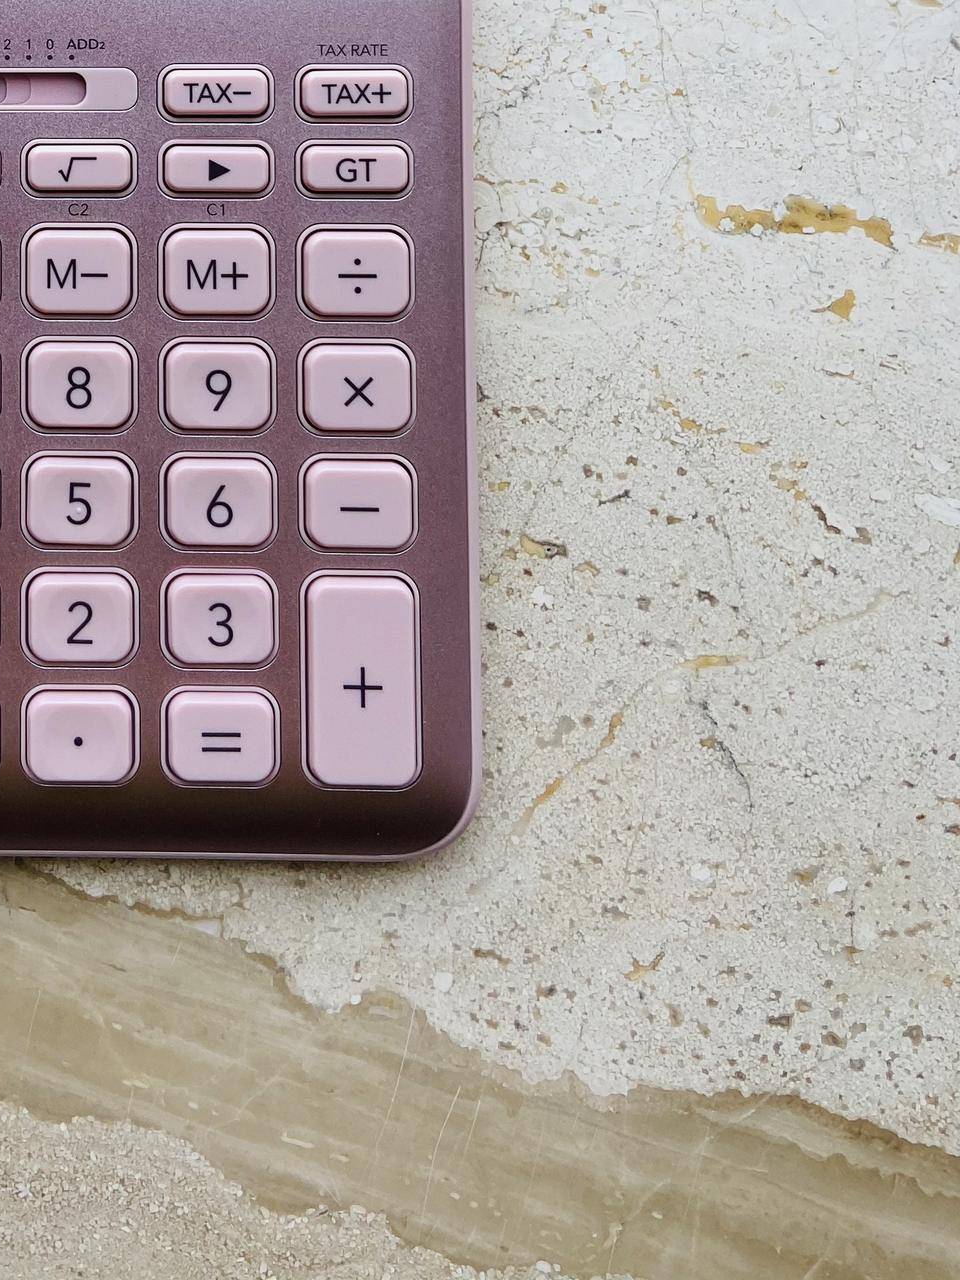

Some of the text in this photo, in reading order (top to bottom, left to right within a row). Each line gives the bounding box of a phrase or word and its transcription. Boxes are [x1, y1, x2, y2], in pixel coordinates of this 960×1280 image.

[3, 39, 12, 50] 2
[25, 39, 32, 50] 1
[46, 39, 55, 50] 0
[317, 44, 389, 57] TAX RATE
[321, 83, 392, 105] TAX+
[335, 158, 377, 183] GT
[68, 204, 89, 217] C2
[206, 204, 226, 216] C1
[187, 259, 248, 290] M+
[66, 367, 92, 409] 8
[206, 370, 232, 411] 9
[67, 482, 91, 525] 5
[207, 485, 233, 527] 6
[67, 601, 93, 644] 2
[208, 603, 233, 647] 3
